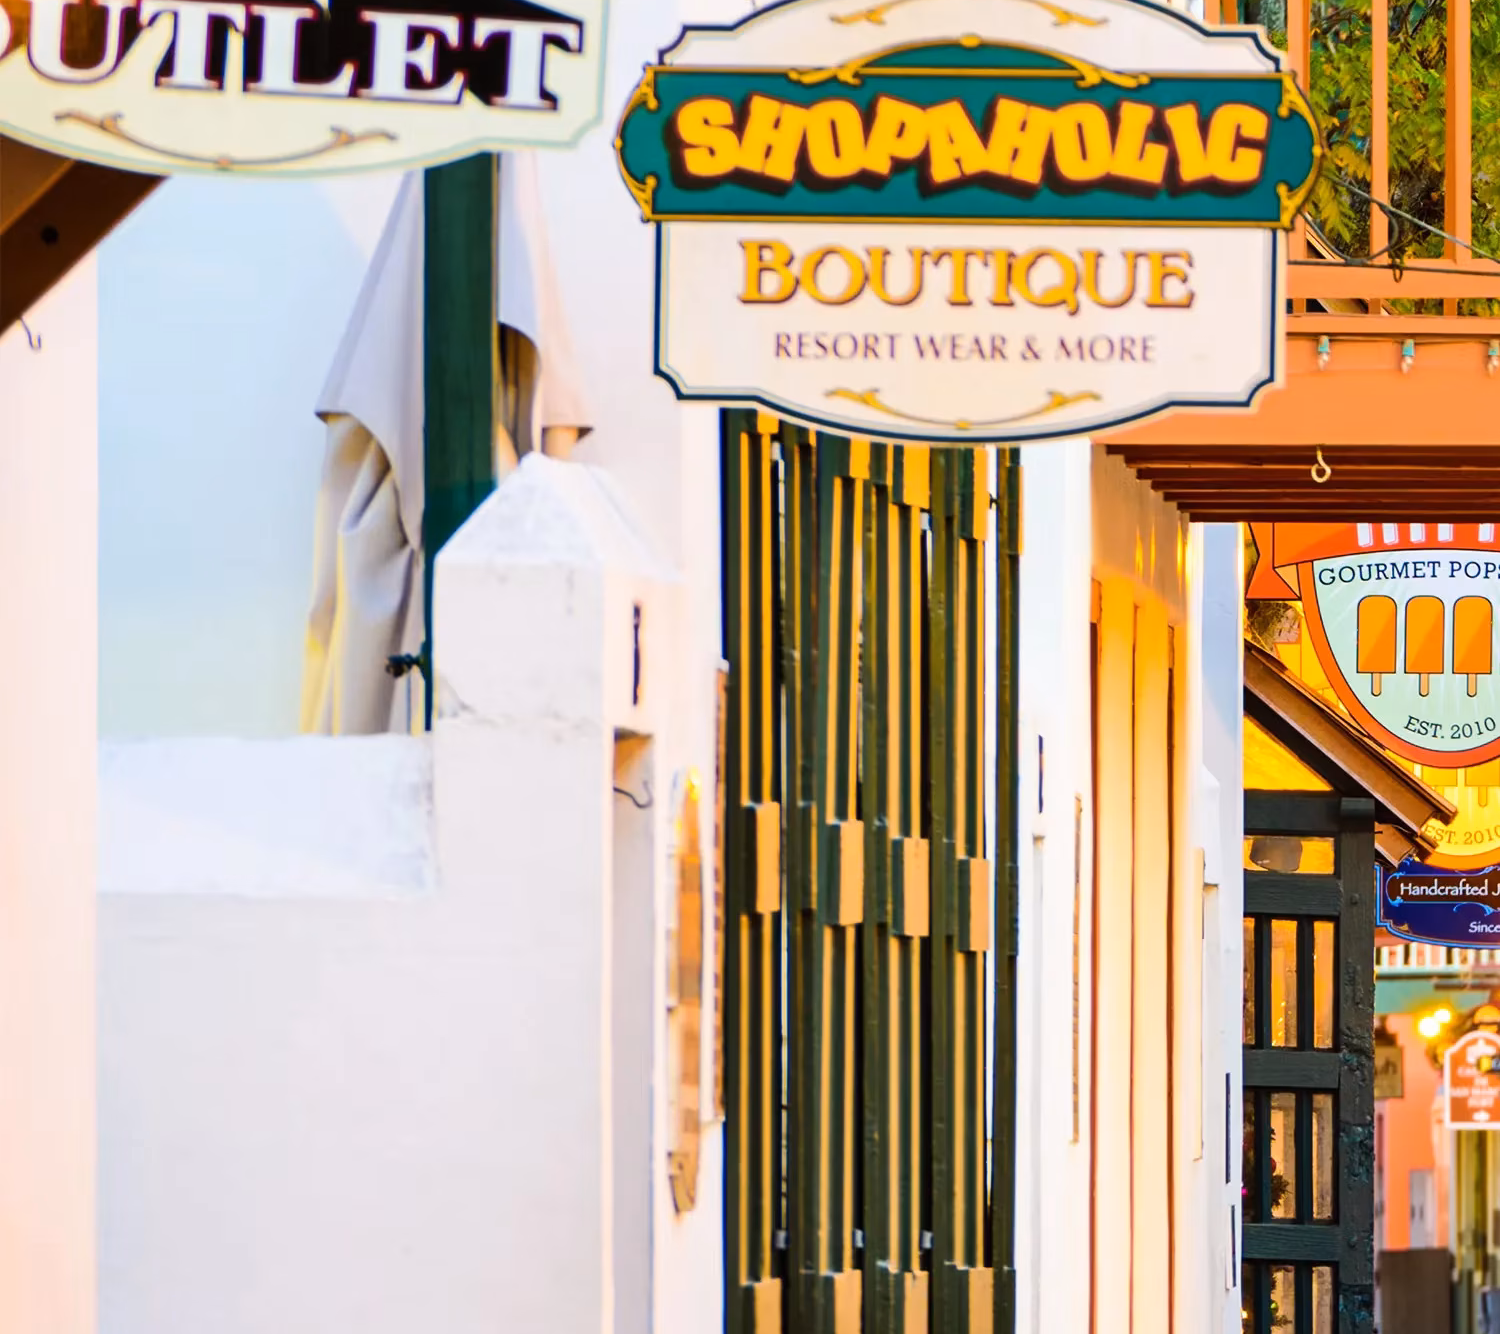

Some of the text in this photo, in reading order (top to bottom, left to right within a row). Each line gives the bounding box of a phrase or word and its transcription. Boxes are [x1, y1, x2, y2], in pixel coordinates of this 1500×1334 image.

[670, 92, 1271, 192] SHOPAHOLIC
[738, 239, 1195, 315] BOUTIQUE
[775, 332, 1156, 364] RESORT WEAR & MORE
[1319, 561, 1441, 586] GOURMET
[1403, 715, 1497, 740] EST. 2010
[1400, 878, 1489, 897] Handcrafted
